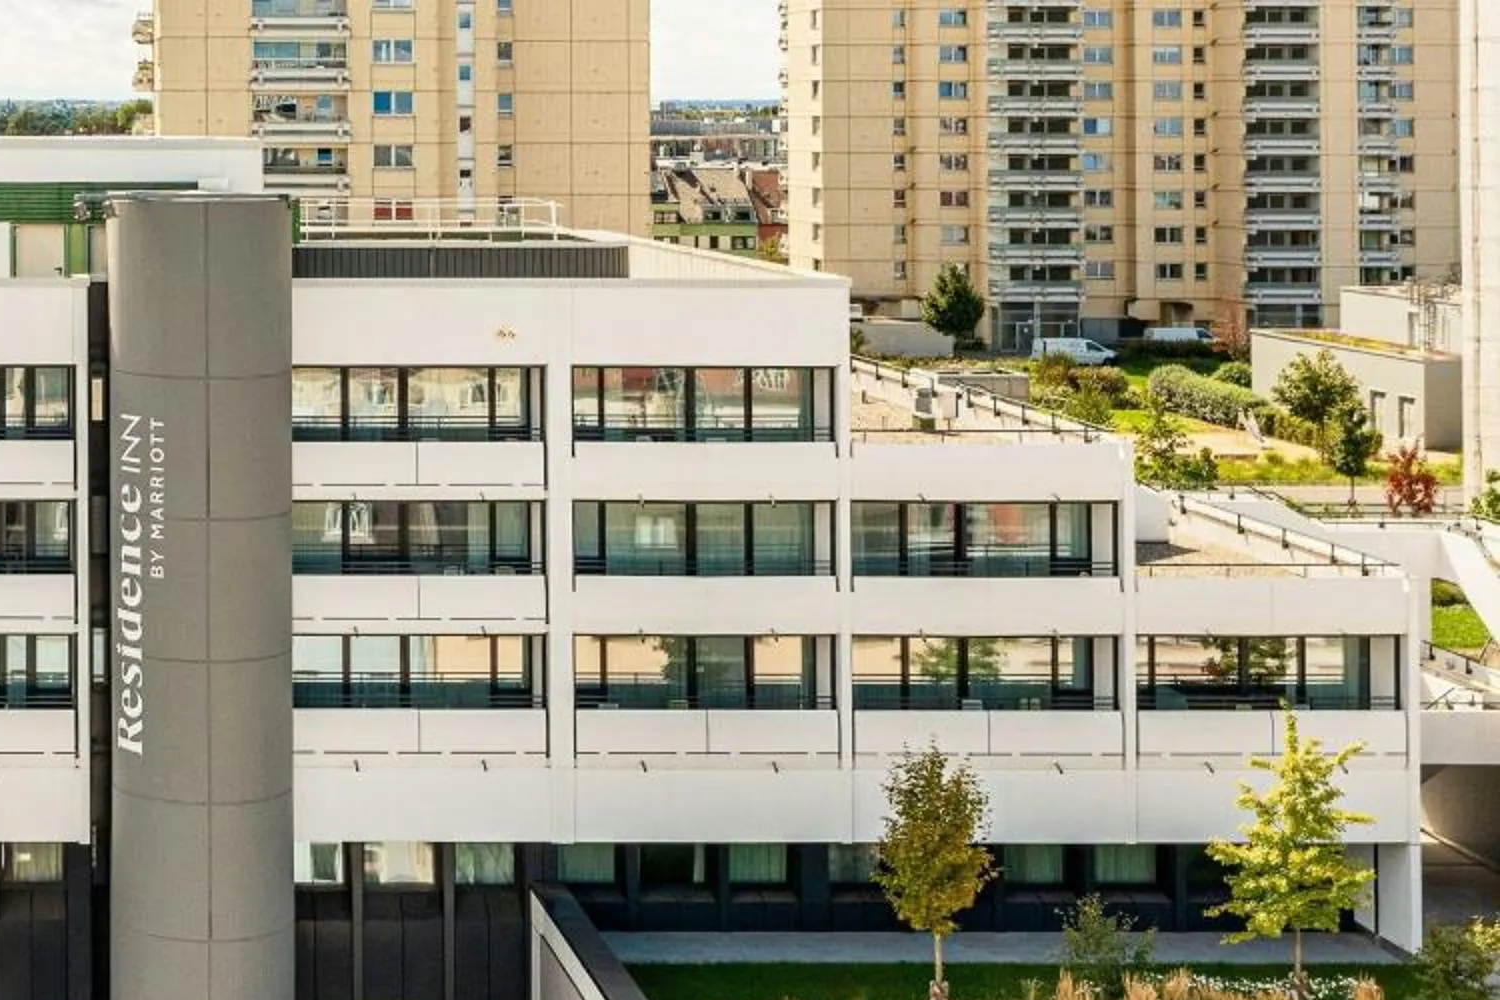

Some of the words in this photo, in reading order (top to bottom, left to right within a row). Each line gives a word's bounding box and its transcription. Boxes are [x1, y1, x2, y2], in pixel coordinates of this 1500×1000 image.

[120, 413, 142, 473] INN
[150, 417, 165, 540] MARRIOTT
[150, 552, 165, 579] BY
[116, 484, 143, 755] Residence
